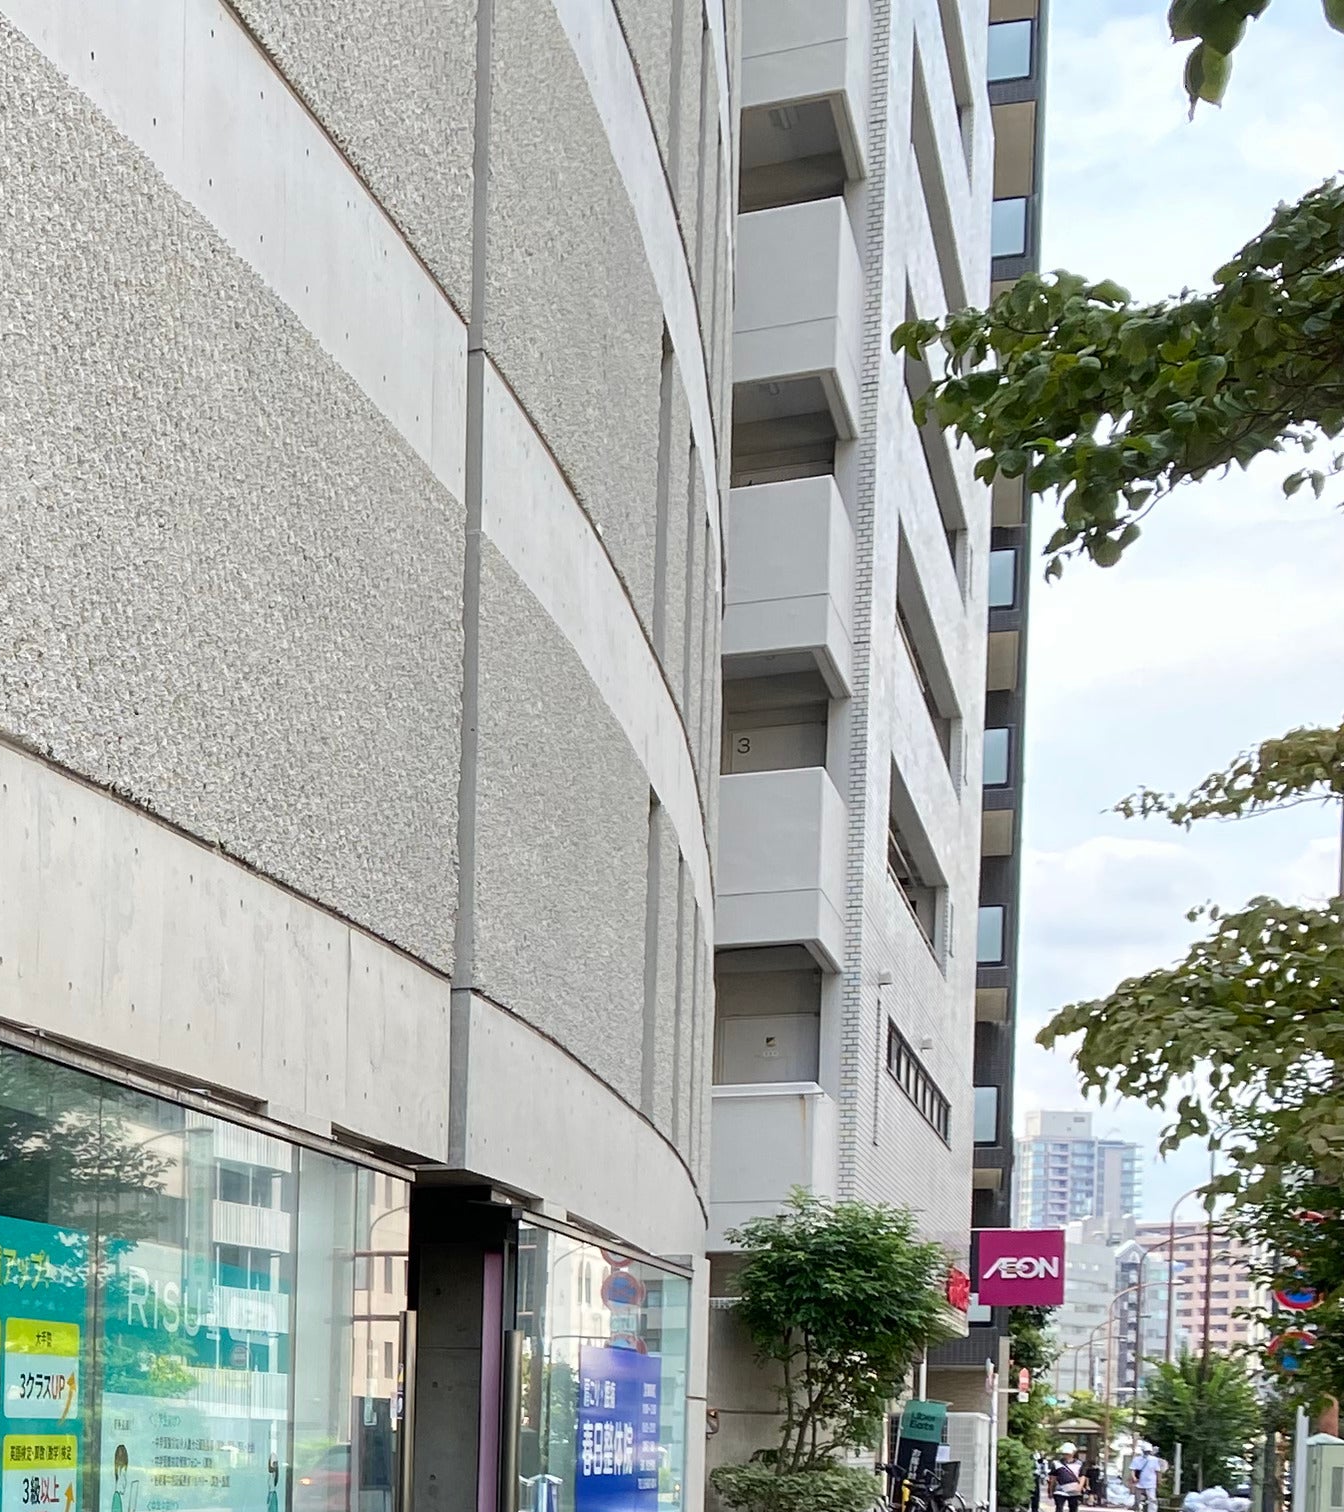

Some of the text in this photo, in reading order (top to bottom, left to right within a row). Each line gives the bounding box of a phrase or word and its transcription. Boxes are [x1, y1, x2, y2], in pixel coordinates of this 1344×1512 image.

[736, 737, 751, 754] 3
[19, 1373, 66, 1400] 3クラスUP
